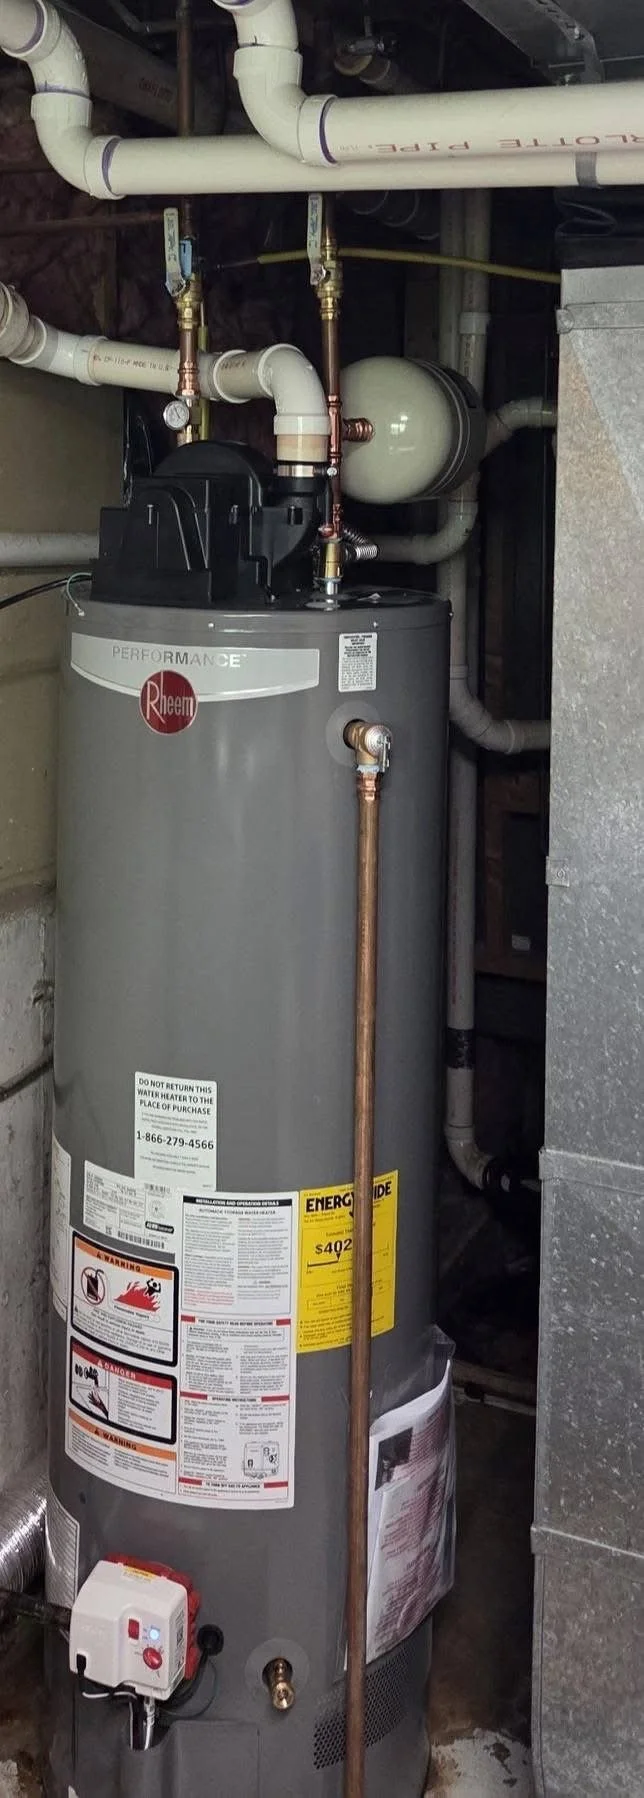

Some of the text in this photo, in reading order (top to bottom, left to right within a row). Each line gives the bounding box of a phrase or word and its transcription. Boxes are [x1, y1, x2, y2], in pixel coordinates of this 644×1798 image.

[375, 141, 470, 152] PIPE
[146, 671, 194, 724] Rheem
[138, 1077, 212, 1094] DO NOT RETURN THIS
[137, 1088, 214, 1105] WATER HEATER TO THE
[139, 1099, 212, 1116] PLACE OF PURCHASE
[136, 1130, 214, 1150] 1-866-279-4566
[315, 1238, 353, 1255] $402
[104, 1254, 141, 1273] WARNING
[104, 1362, 136, 1380] DANGER
[102, 1431, 137, 1451] WARNING
